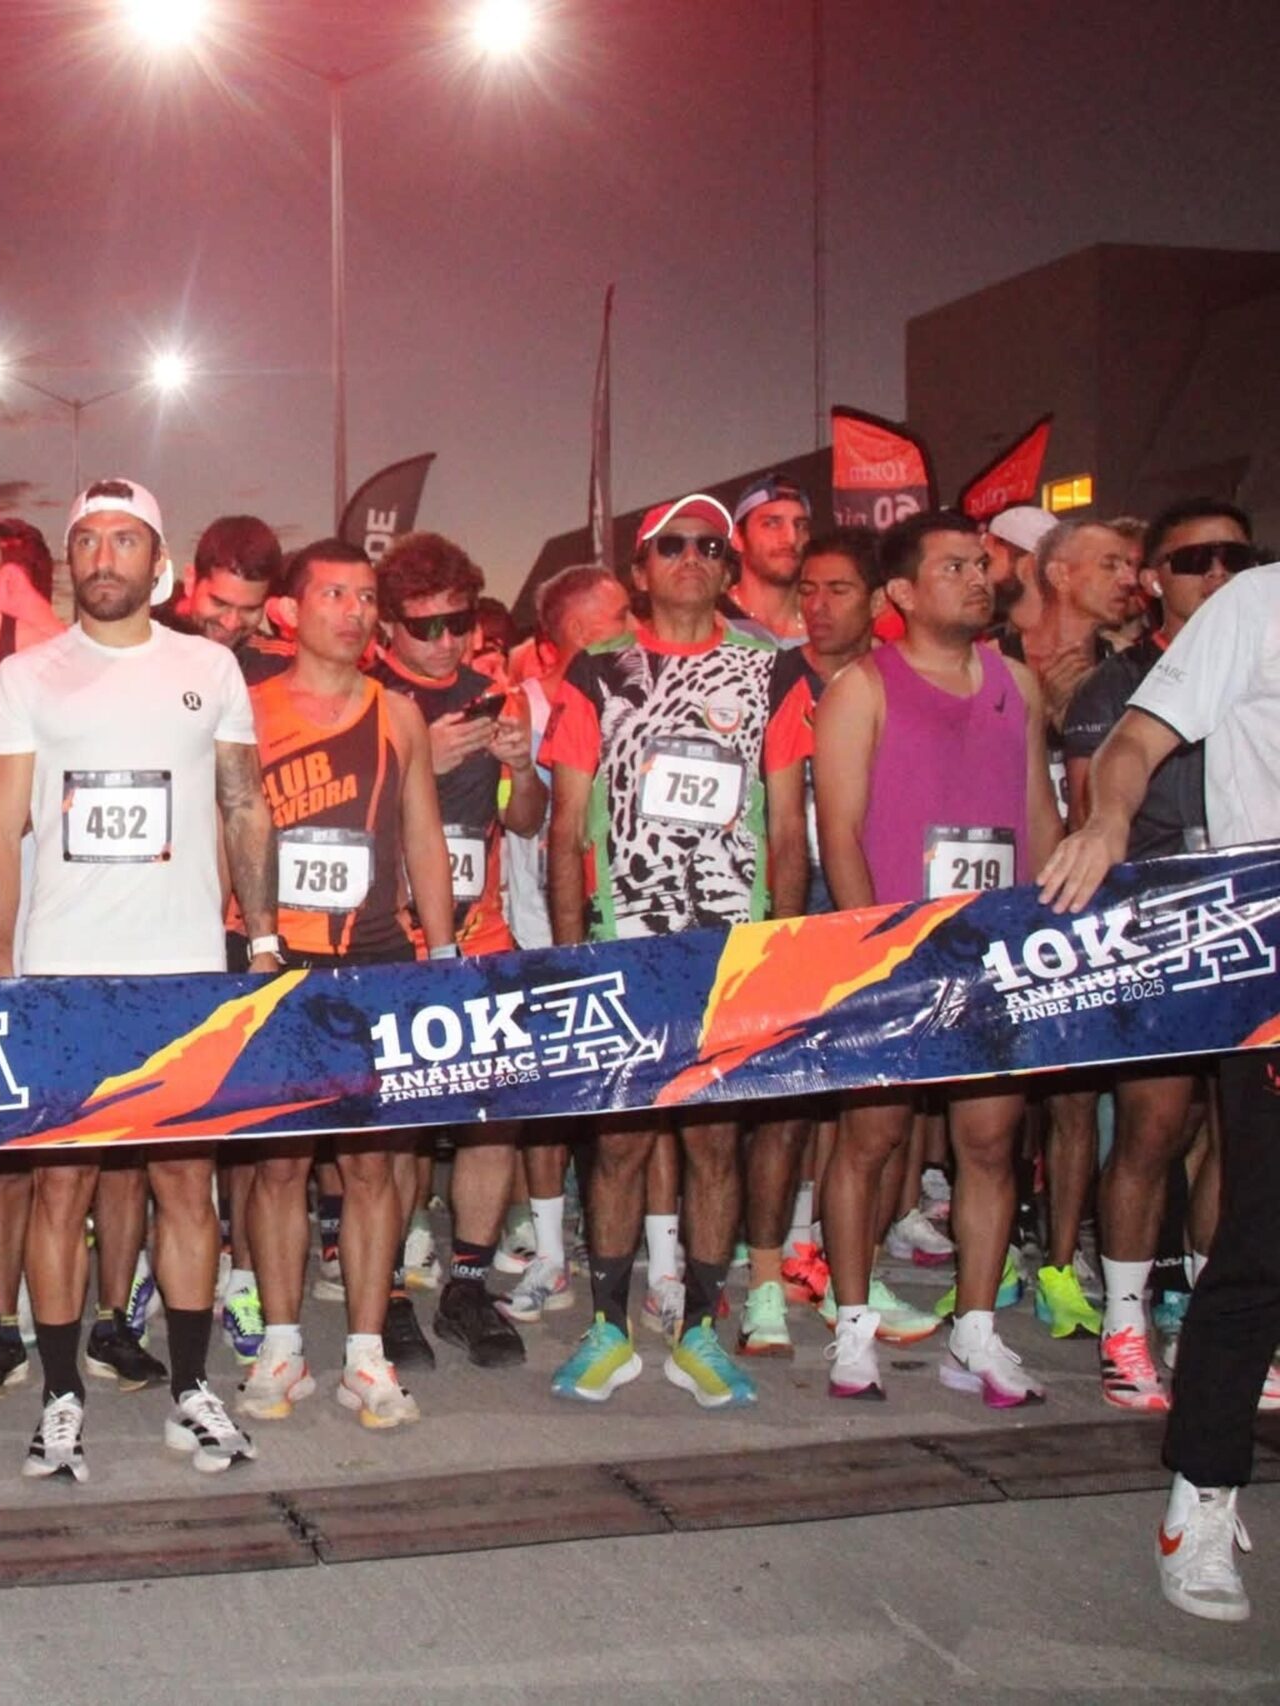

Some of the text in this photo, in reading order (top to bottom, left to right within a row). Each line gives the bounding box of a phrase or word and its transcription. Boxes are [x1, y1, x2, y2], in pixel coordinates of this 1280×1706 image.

[665, 771, 720, 808] 752
[86, 805, 148, 840] 432
[293, 859, 349, 893] 738
[951, 857, 1000, 890] 219
[981, 907, 1151, 993] 10K
[1005, 960, 1161, 1010] ANÁHUAC
[1010, 979, 1165, 1024] FINBE ABC 2025
[370, 990, 533, 1070] 10K
[378, 1070, 541, 1104] FINBE ABC 2025
[379, 1051, 537, 1093] ANÁHUAC
